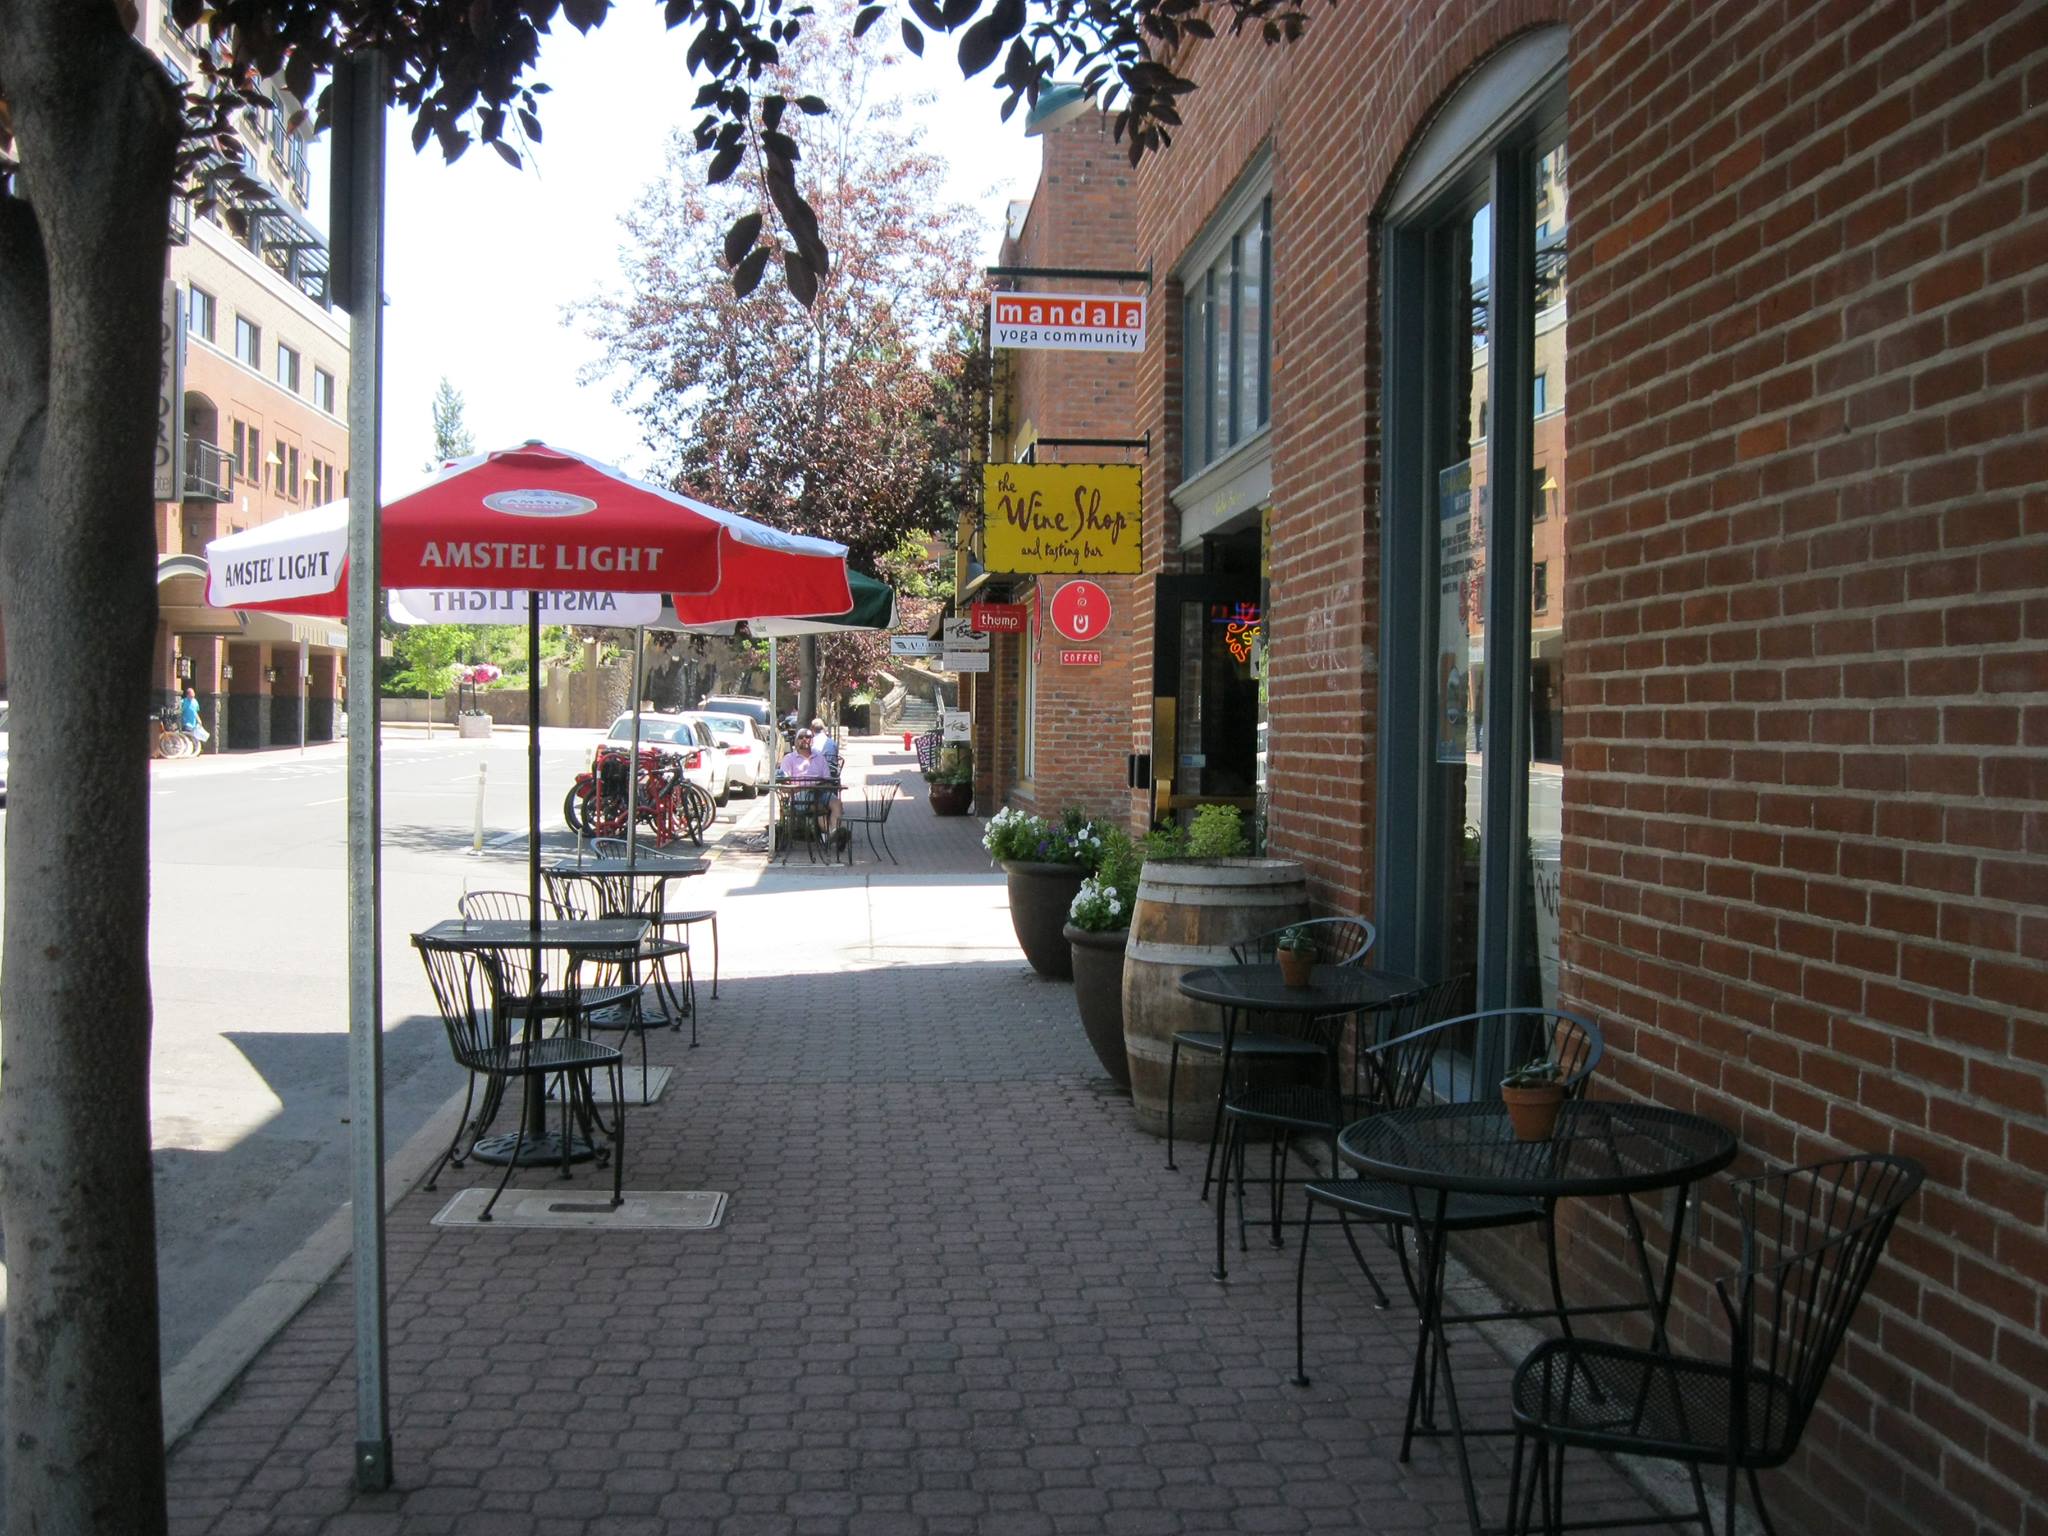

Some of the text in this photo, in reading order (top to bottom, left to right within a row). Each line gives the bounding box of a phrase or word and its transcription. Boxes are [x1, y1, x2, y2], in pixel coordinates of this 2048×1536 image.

[999, 301, 1139, 327] mandala
[1000, 329, 1138, 346] yoga community
[998, 472, 1017, 493] the
[998, 485, 1127, 545] Wine Shop
[420, 542, 663, 571] AMSTEL LIGHT
[1021, 537, 1103, 566] and tasting bar
[225, 551, 329, 588] AMSTEL LIGHT
[981, 613, 1018, 629] thump
